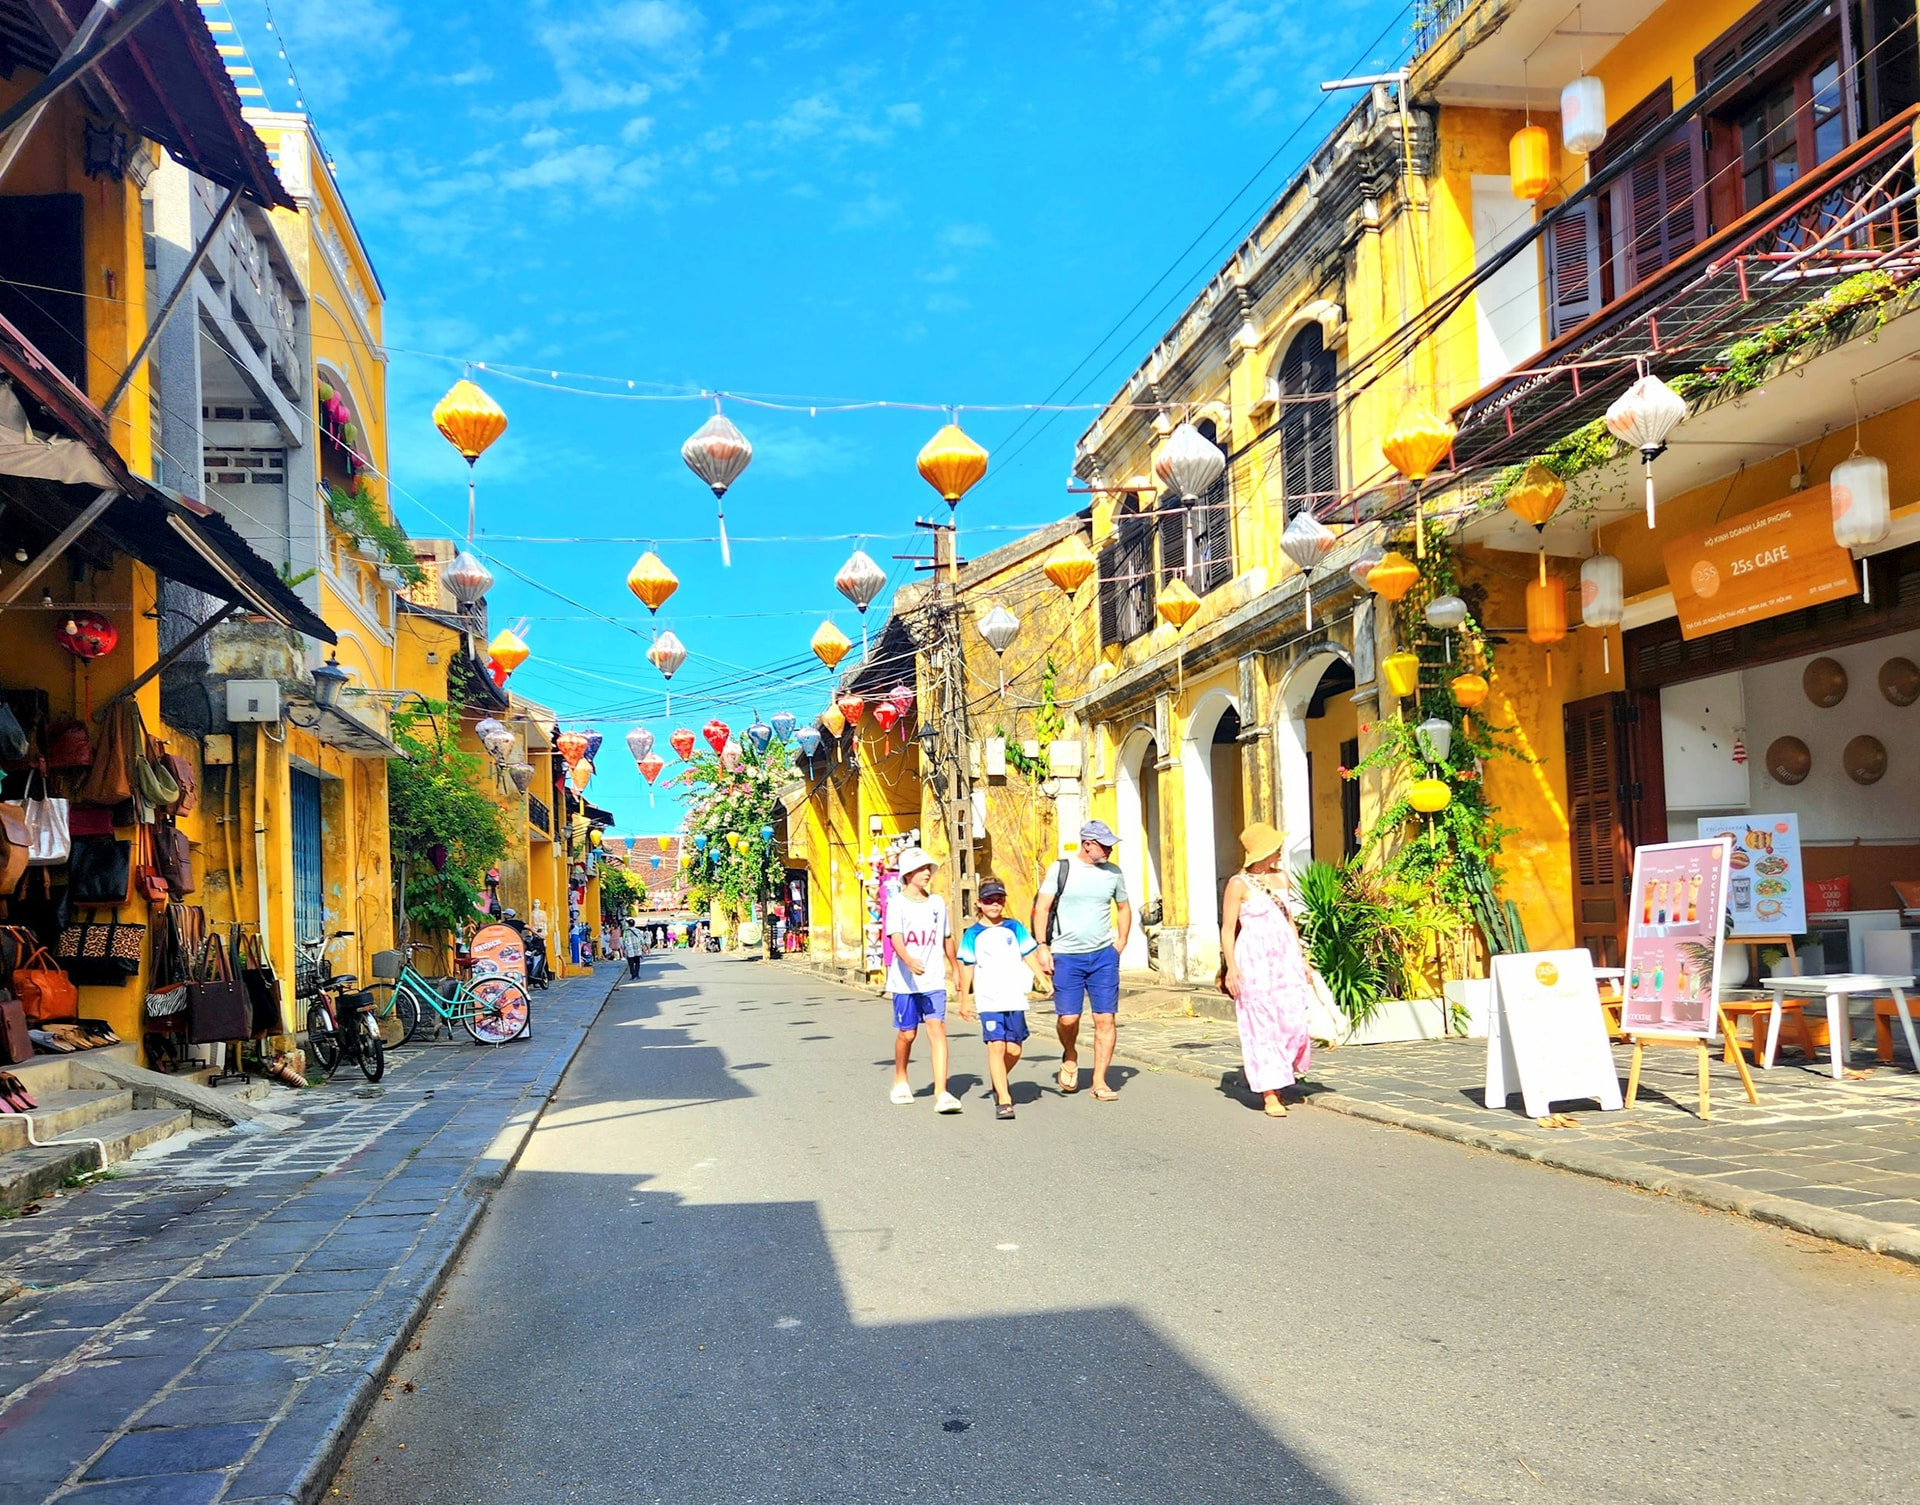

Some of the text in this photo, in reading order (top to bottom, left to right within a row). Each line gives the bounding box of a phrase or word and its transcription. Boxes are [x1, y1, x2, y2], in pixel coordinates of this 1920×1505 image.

[1714, 533, 1729, 544] KINH
[1729, 524, 1752, 538] DOANH
[1767, 510, 1792, 524] PHONG
[1731, 545, 1789, 576] 25s CAFE
[904, 929, 937, 946] AIA
